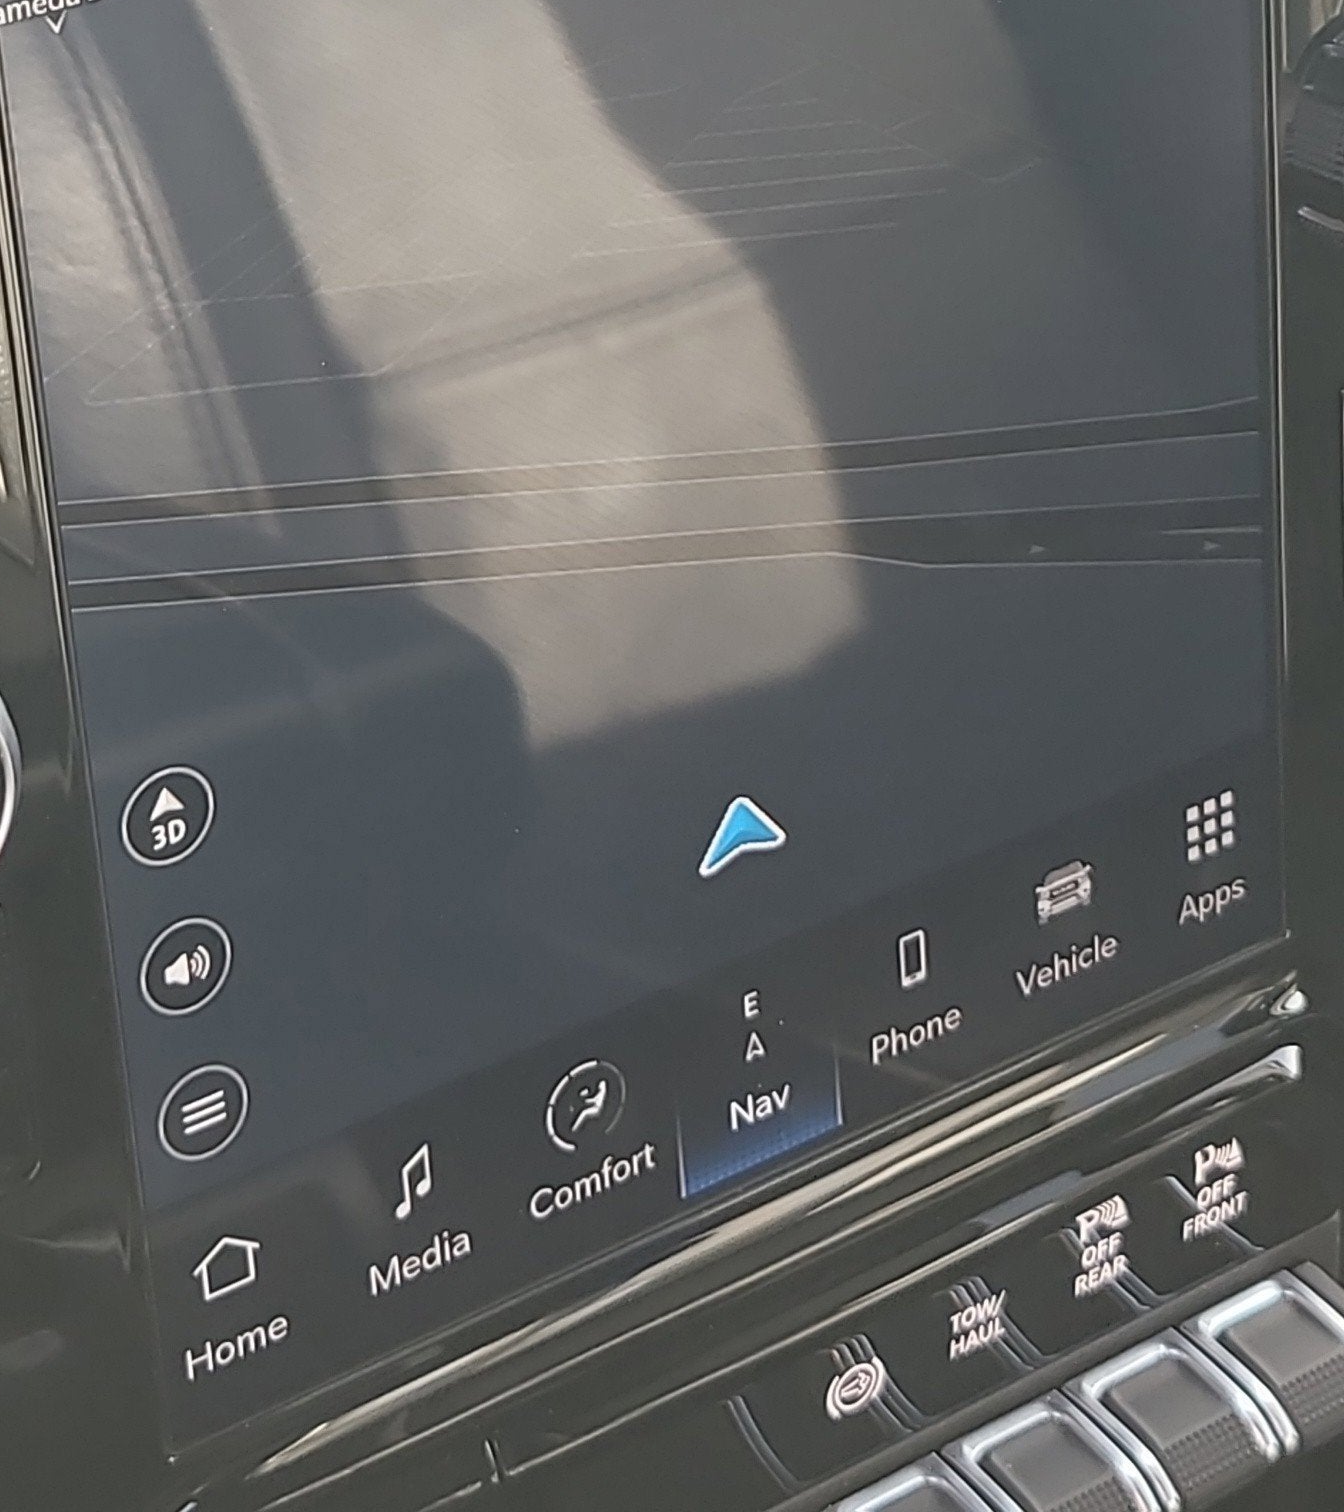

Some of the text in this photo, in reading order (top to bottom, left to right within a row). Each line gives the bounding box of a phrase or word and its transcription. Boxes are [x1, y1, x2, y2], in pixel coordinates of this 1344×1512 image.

[151, 818, 187, 851] 3D
[1178, 876, 1248, 925] Apps
[1016, 934, 1120, 996] Vehicle
[871, 1005, 963, 1066] Phone
[729, 1083, 792, 1134] Nav
[528, 1143, 656, 1221] Comfort
[1197, 1173, 1238, 1211] OFF
[1182, 1191, 1248, 1242] FRONT
[368, 1230, 473, 1297] Media
[1074, 1254, 1129, 1299] REAR
[1082, 1232, 1123, 1271] OFF
[950, 1289, 1006, 1335] TOW/
[183, 1315, 290, 1380] Home
[949, 1317, 1005, 1362] HAUL
